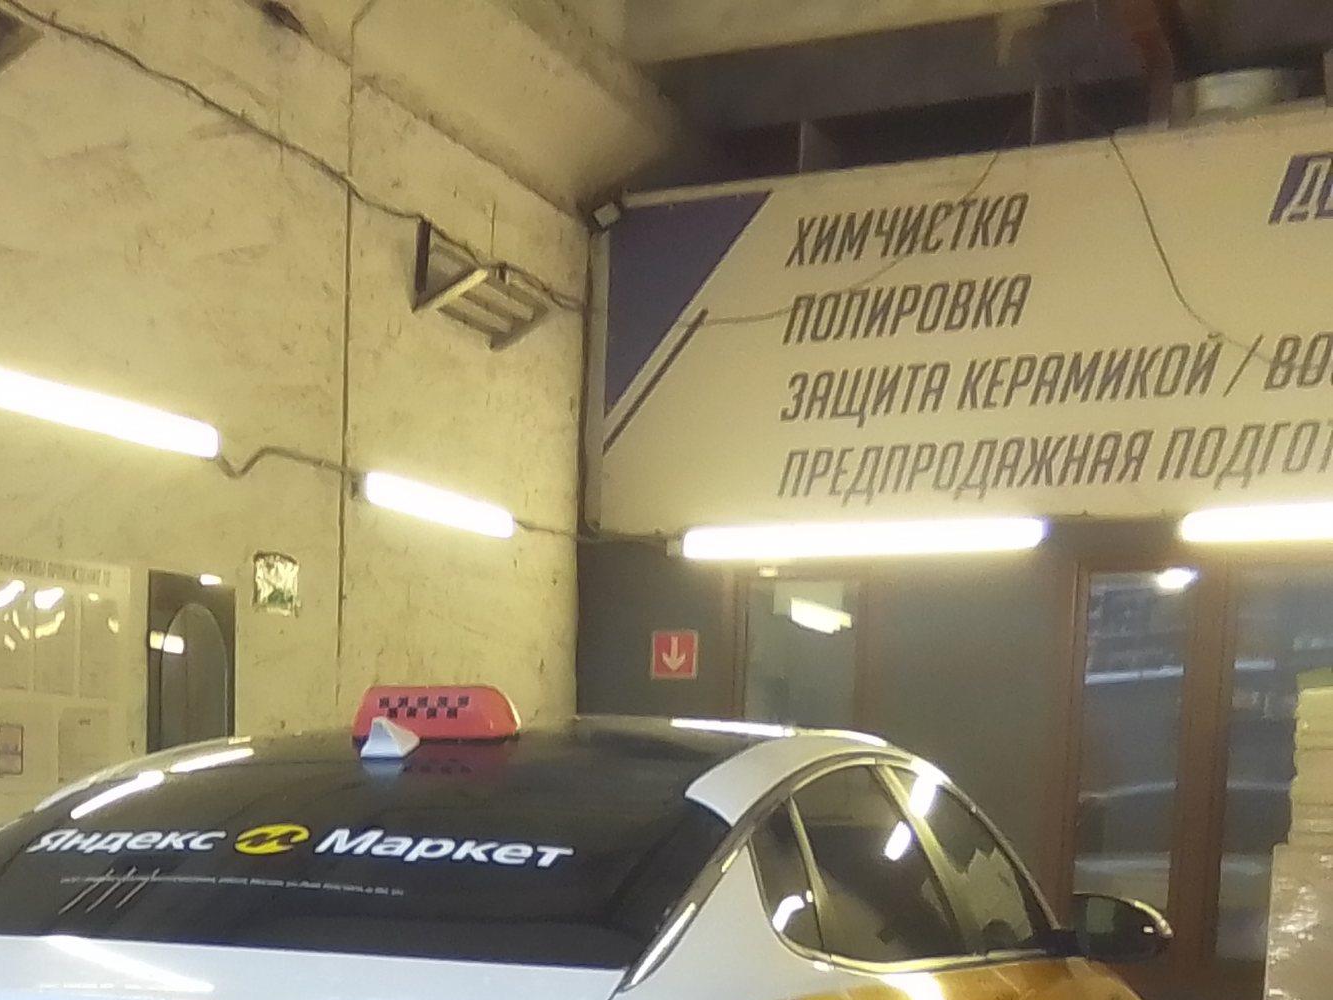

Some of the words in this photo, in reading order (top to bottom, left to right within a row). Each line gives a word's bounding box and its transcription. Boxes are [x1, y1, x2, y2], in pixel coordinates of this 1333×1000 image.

[784, 192, 1030, 268] ХИМЧИСТКА
[781, 273, 1032, 346] ПОЛИРОВКА
[780, 362, 951, 428] ЗАЩИТА
[956, 331, 1224, 412] КЕРАМИКОЙ
[1264, 331, 1333, 391] ВО
[777, 430, 1154, 508] ПРЕДПРОДАЖНАЯ
[26, 828, 227, 855] Яндекс
[314, 827, 575, 870] Маркет
